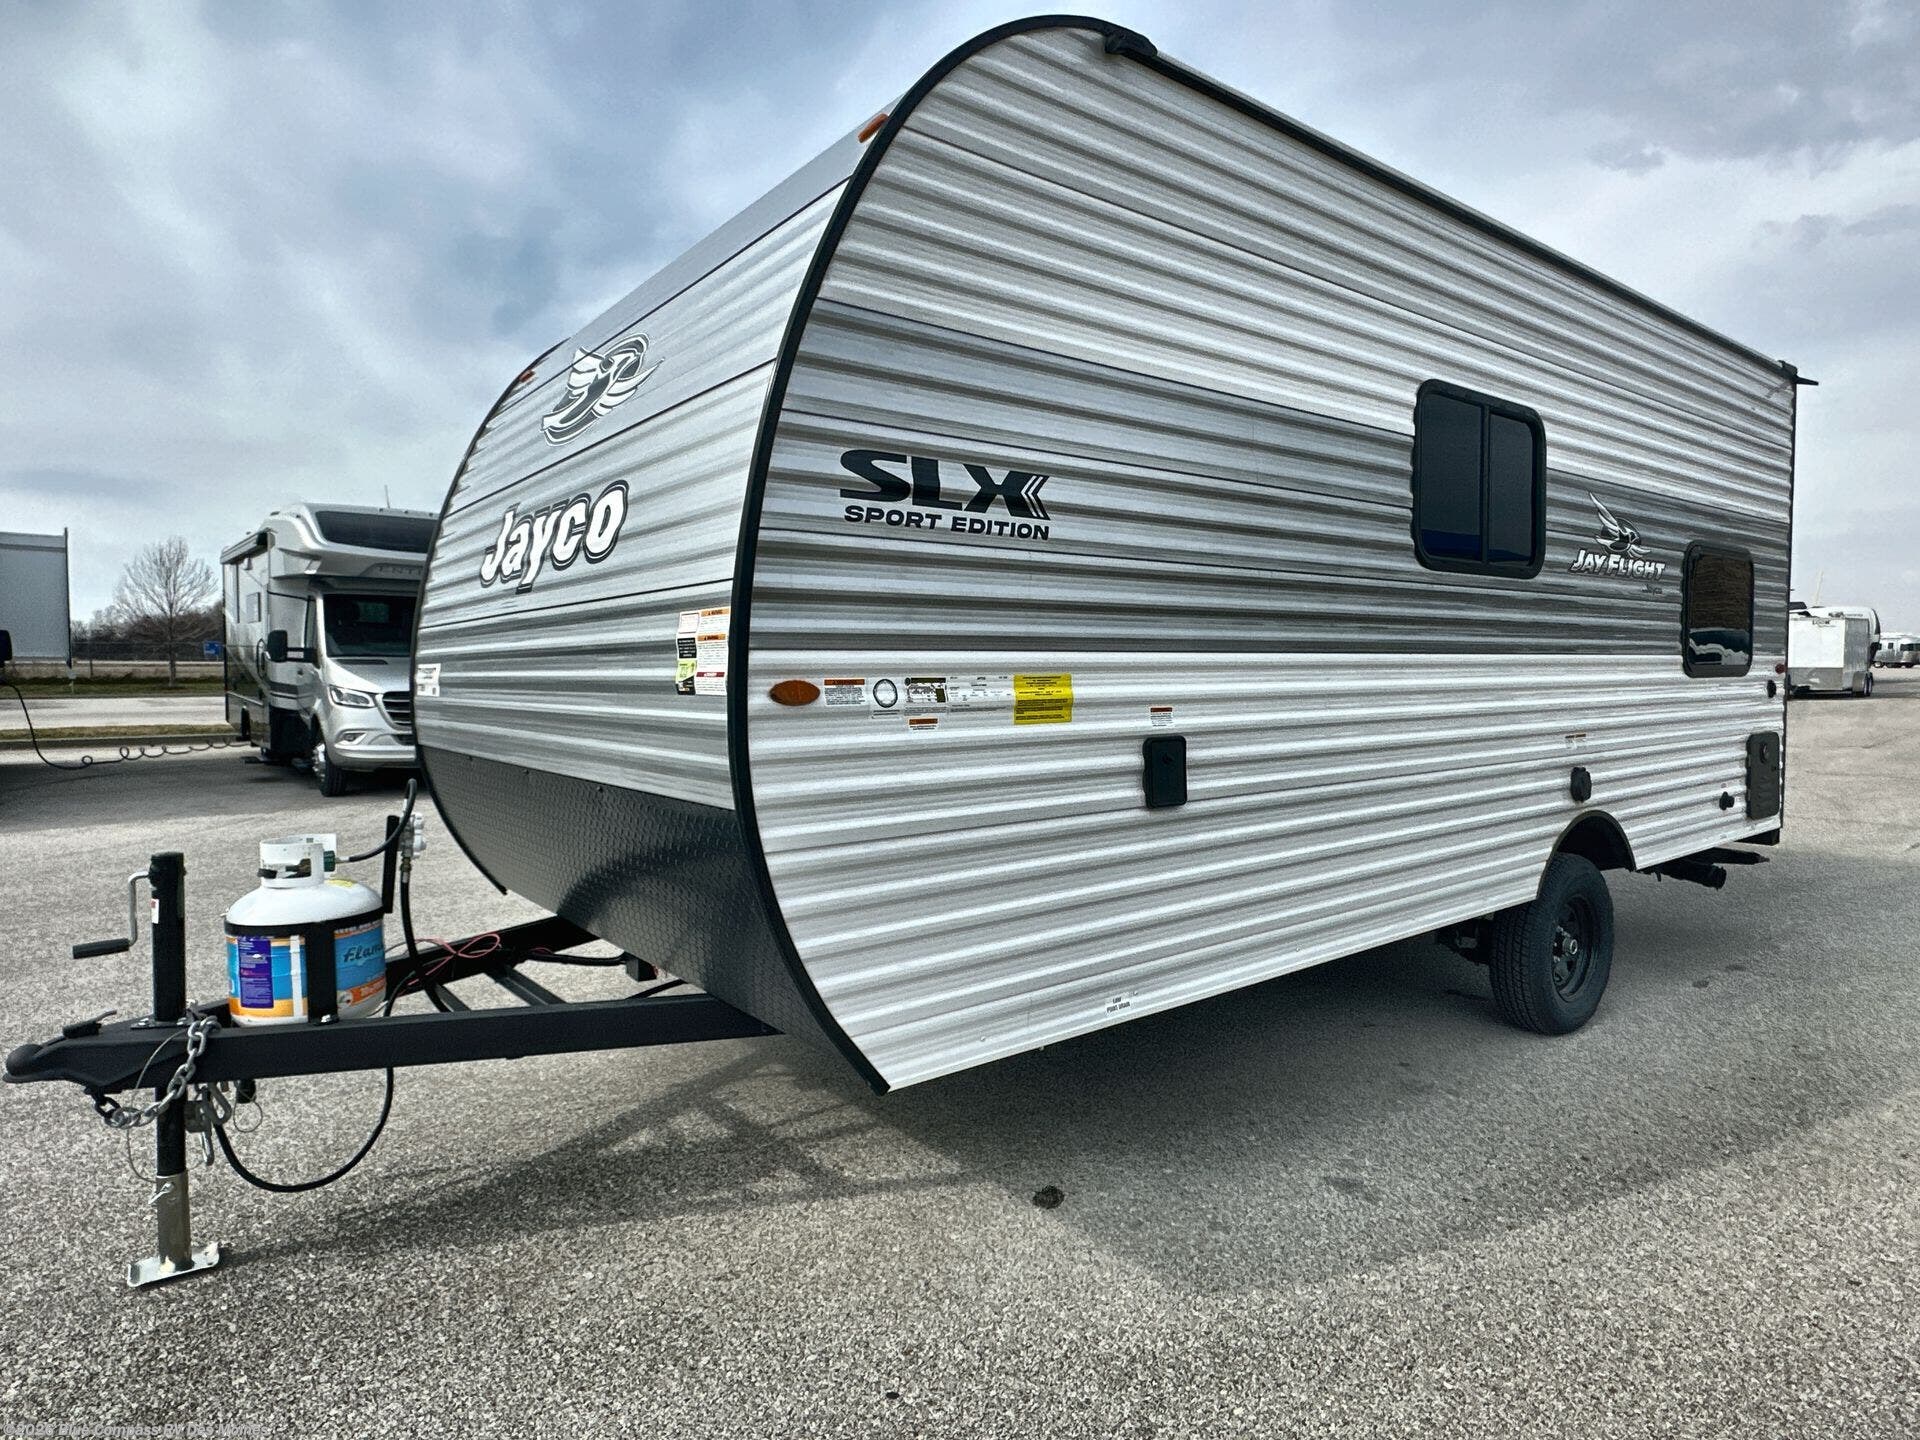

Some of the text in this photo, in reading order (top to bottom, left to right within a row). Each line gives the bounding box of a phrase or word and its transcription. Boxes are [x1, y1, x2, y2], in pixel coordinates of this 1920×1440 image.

[840, 449, 1050, 520] SLX
[480, 479, 629, 595] Jayco
[844, 505, 1049, 540] SPORT EDITION
[1570, 548, 1666, 580] JAY FLIGHT
